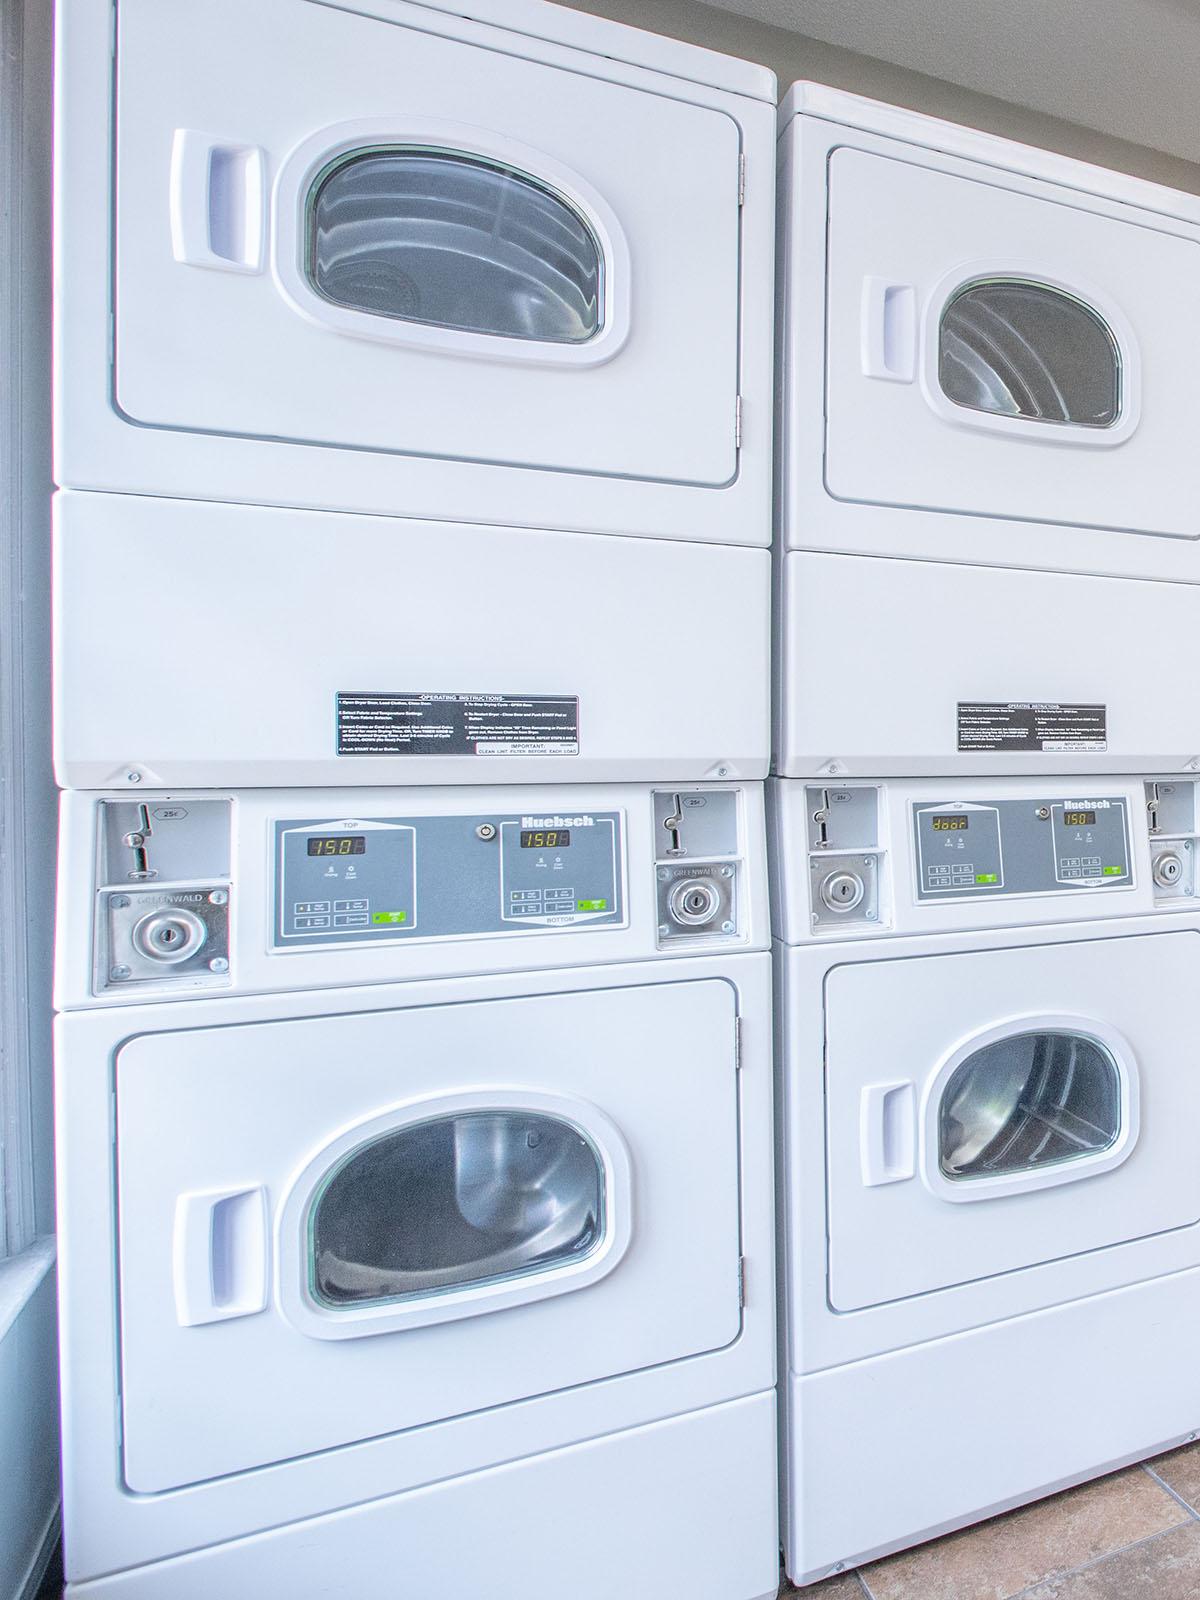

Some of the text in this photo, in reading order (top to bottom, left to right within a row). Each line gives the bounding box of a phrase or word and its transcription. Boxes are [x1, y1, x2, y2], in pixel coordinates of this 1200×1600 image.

[1064, 800, 1110, 809] Huebsch
[521, 816, 594, 828] Huebsch
[1066, 814, 1086, 824] 150
[527, 832, 557, 847] 150
[316, 839, 352, 855] 150
